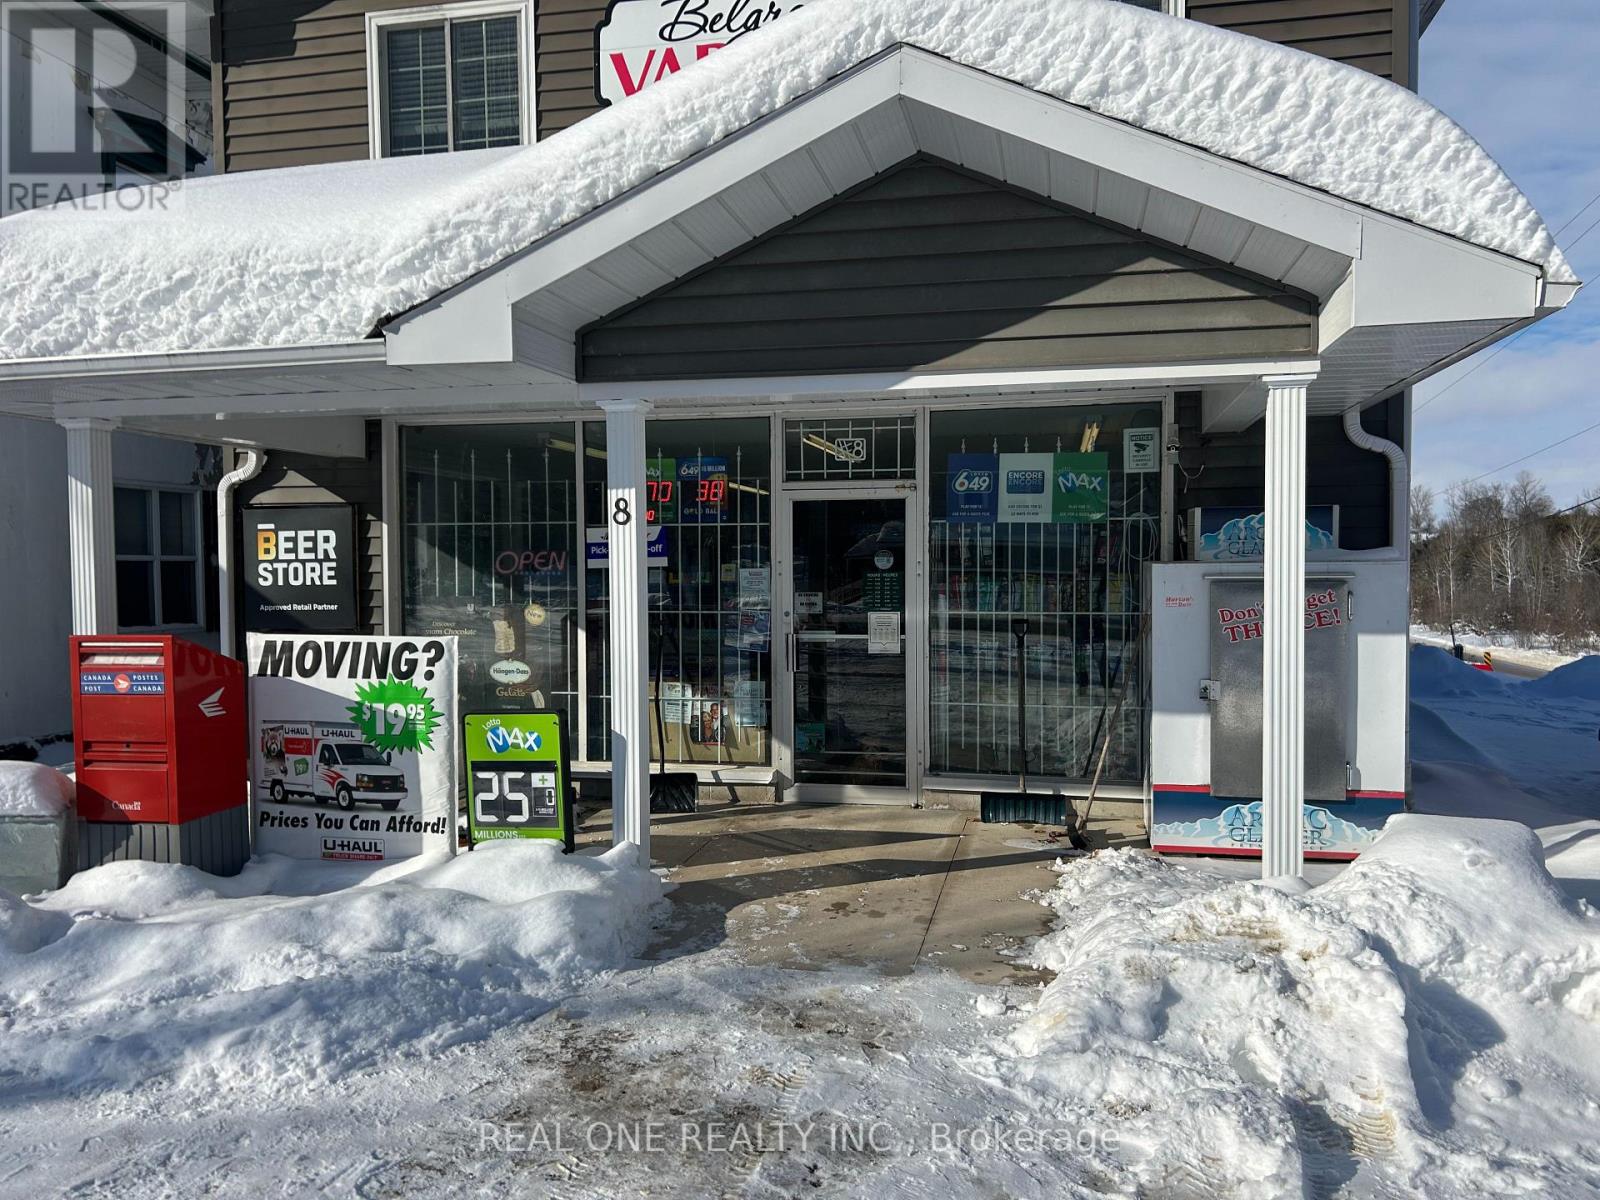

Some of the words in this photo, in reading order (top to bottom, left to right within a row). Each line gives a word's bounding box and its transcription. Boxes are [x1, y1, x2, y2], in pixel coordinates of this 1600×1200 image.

[954, 472, 990, 492] 649
[1058, 472, 1102, 494] MAX
[613, 497, 632, 526] 8
[257, 527, 337, 560] BEER
[496, 551, 566, 574] OPEN
[257, 561, 337, 587] STORE
[260, 604, 292, 612] Approved
[293, 603, 312, 611] Retail
[313, 603, 338, 611] Partner
[1219, 600, 1265, 625] Don'
[1305, 588, 1336, 611] get
[443, 627, 477, 636] Chocolate
[1223, 620, 1265, 644] TH
[256, 639, 446, 682] MOVING?
[496, 687, 527, 697] Gelato
[284, 727, 310, 736] U-HAUL
[321, 729, 356, 738] U-HAUL
[482, 718, 501, 731] Lotto
[486, 727, 539, 754] MAX
[475, 771, 530, 822] 25
[259, 810, 309, 829] Prices
[314, 813, 344, 831] You
[349, 815, 381, 832] Can
[386, 816, 447, 835] Afford!
[474, 830, 518, 839] MILLIONS
[323, 839, 383, 853] U-HAUL
